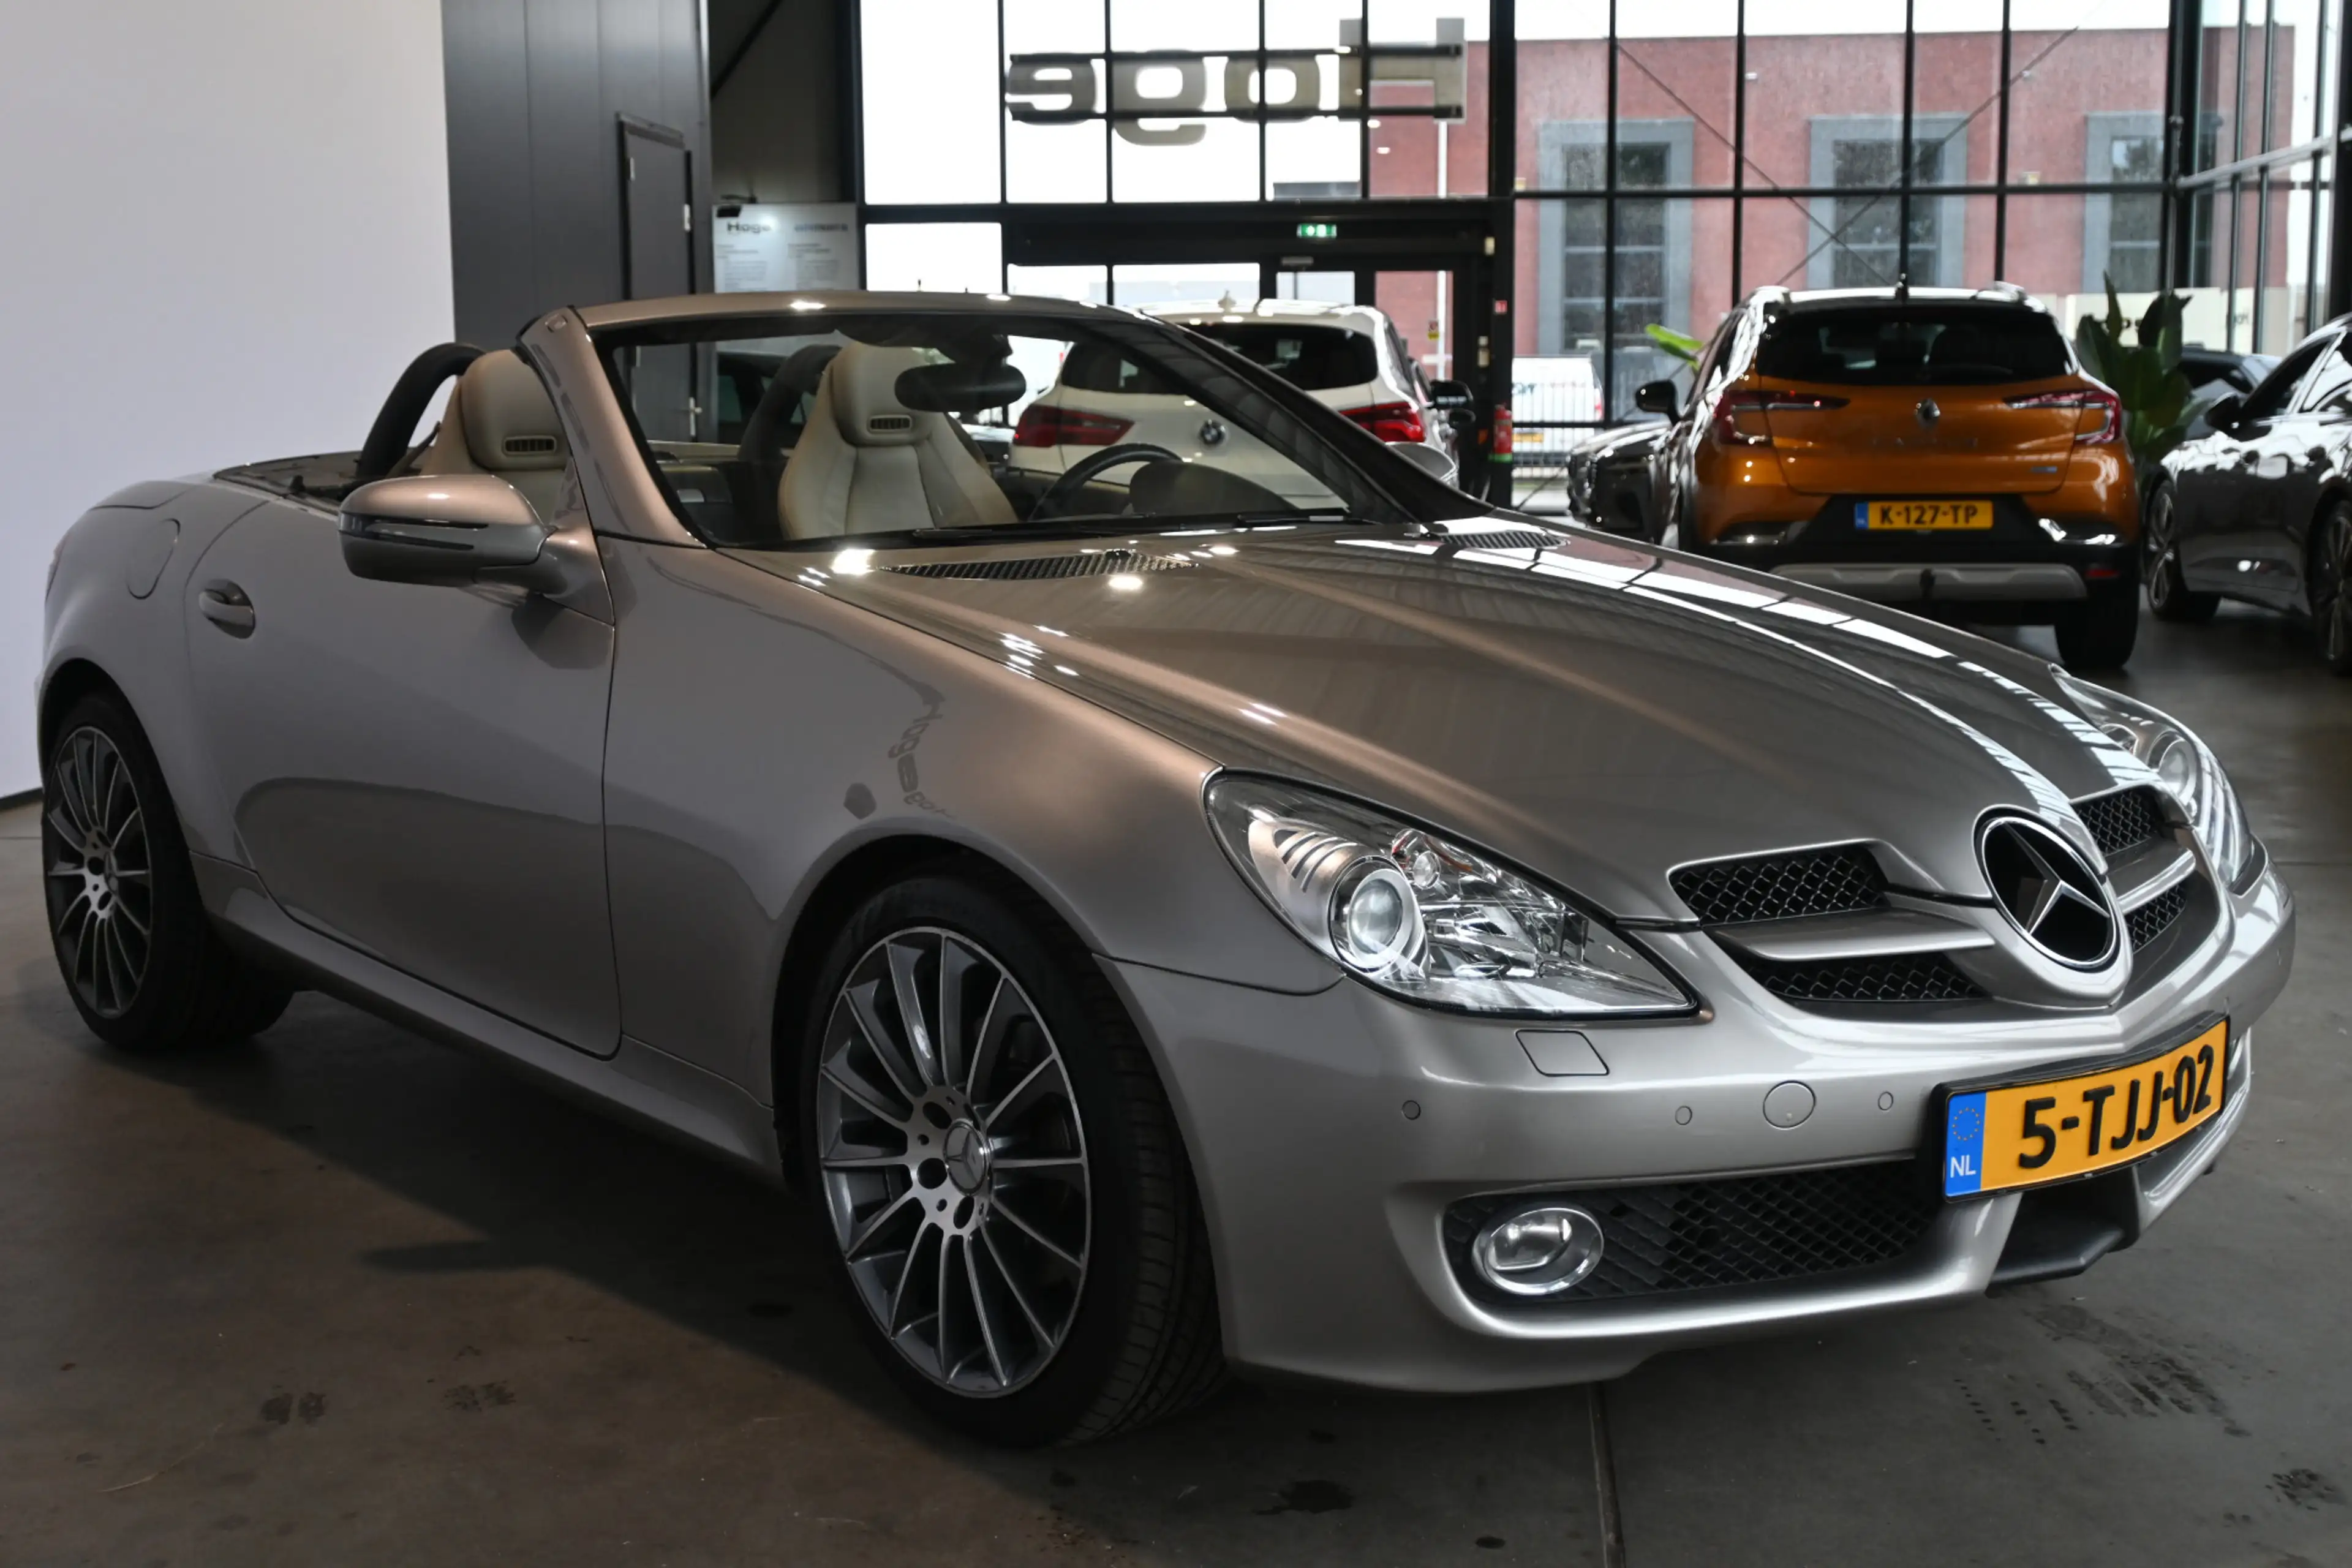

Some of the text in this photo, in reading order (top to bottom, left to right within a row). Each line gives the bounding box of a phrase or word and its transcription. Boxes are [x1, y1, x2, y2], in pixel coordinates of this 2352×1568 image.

[1880, 505, 1978, 524] K-127-TP
[2018, 1044, 2214, 1169] 5-TJJ-02
[1950, 1155, 1976, 1178] NL
